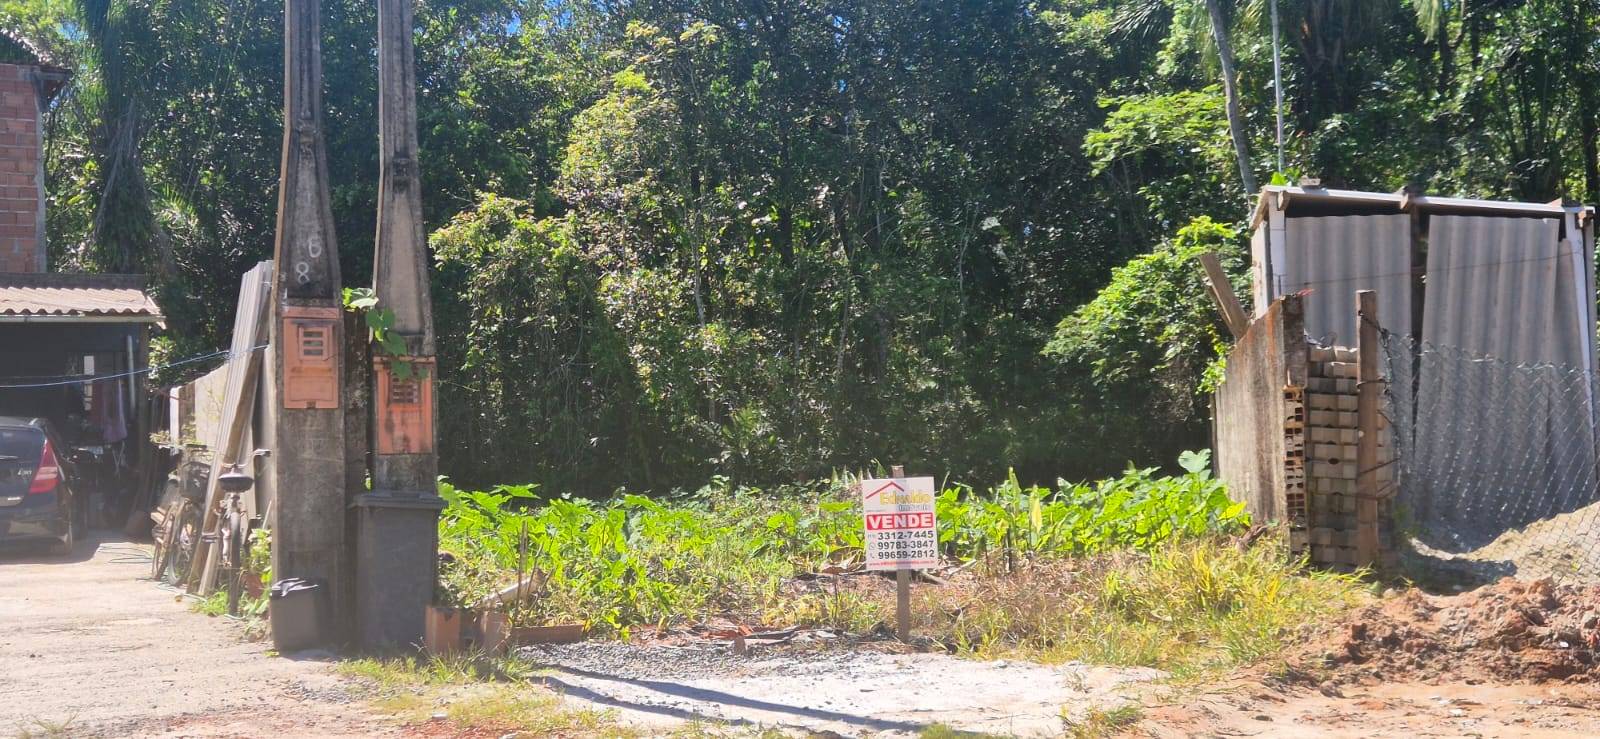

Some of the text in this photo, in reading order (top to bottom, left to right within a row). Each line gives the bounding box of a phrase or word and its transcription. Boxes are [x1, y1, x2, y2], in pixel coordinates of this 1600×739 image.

[296, 262, 310, 284] 8
[868, 513, 932, 529] VENDE
[878, 530, 934, 541] 3312-7445
[878, 540, 934, 550] 99783-3847
[878, 549, 935, 560] 99659-2812
